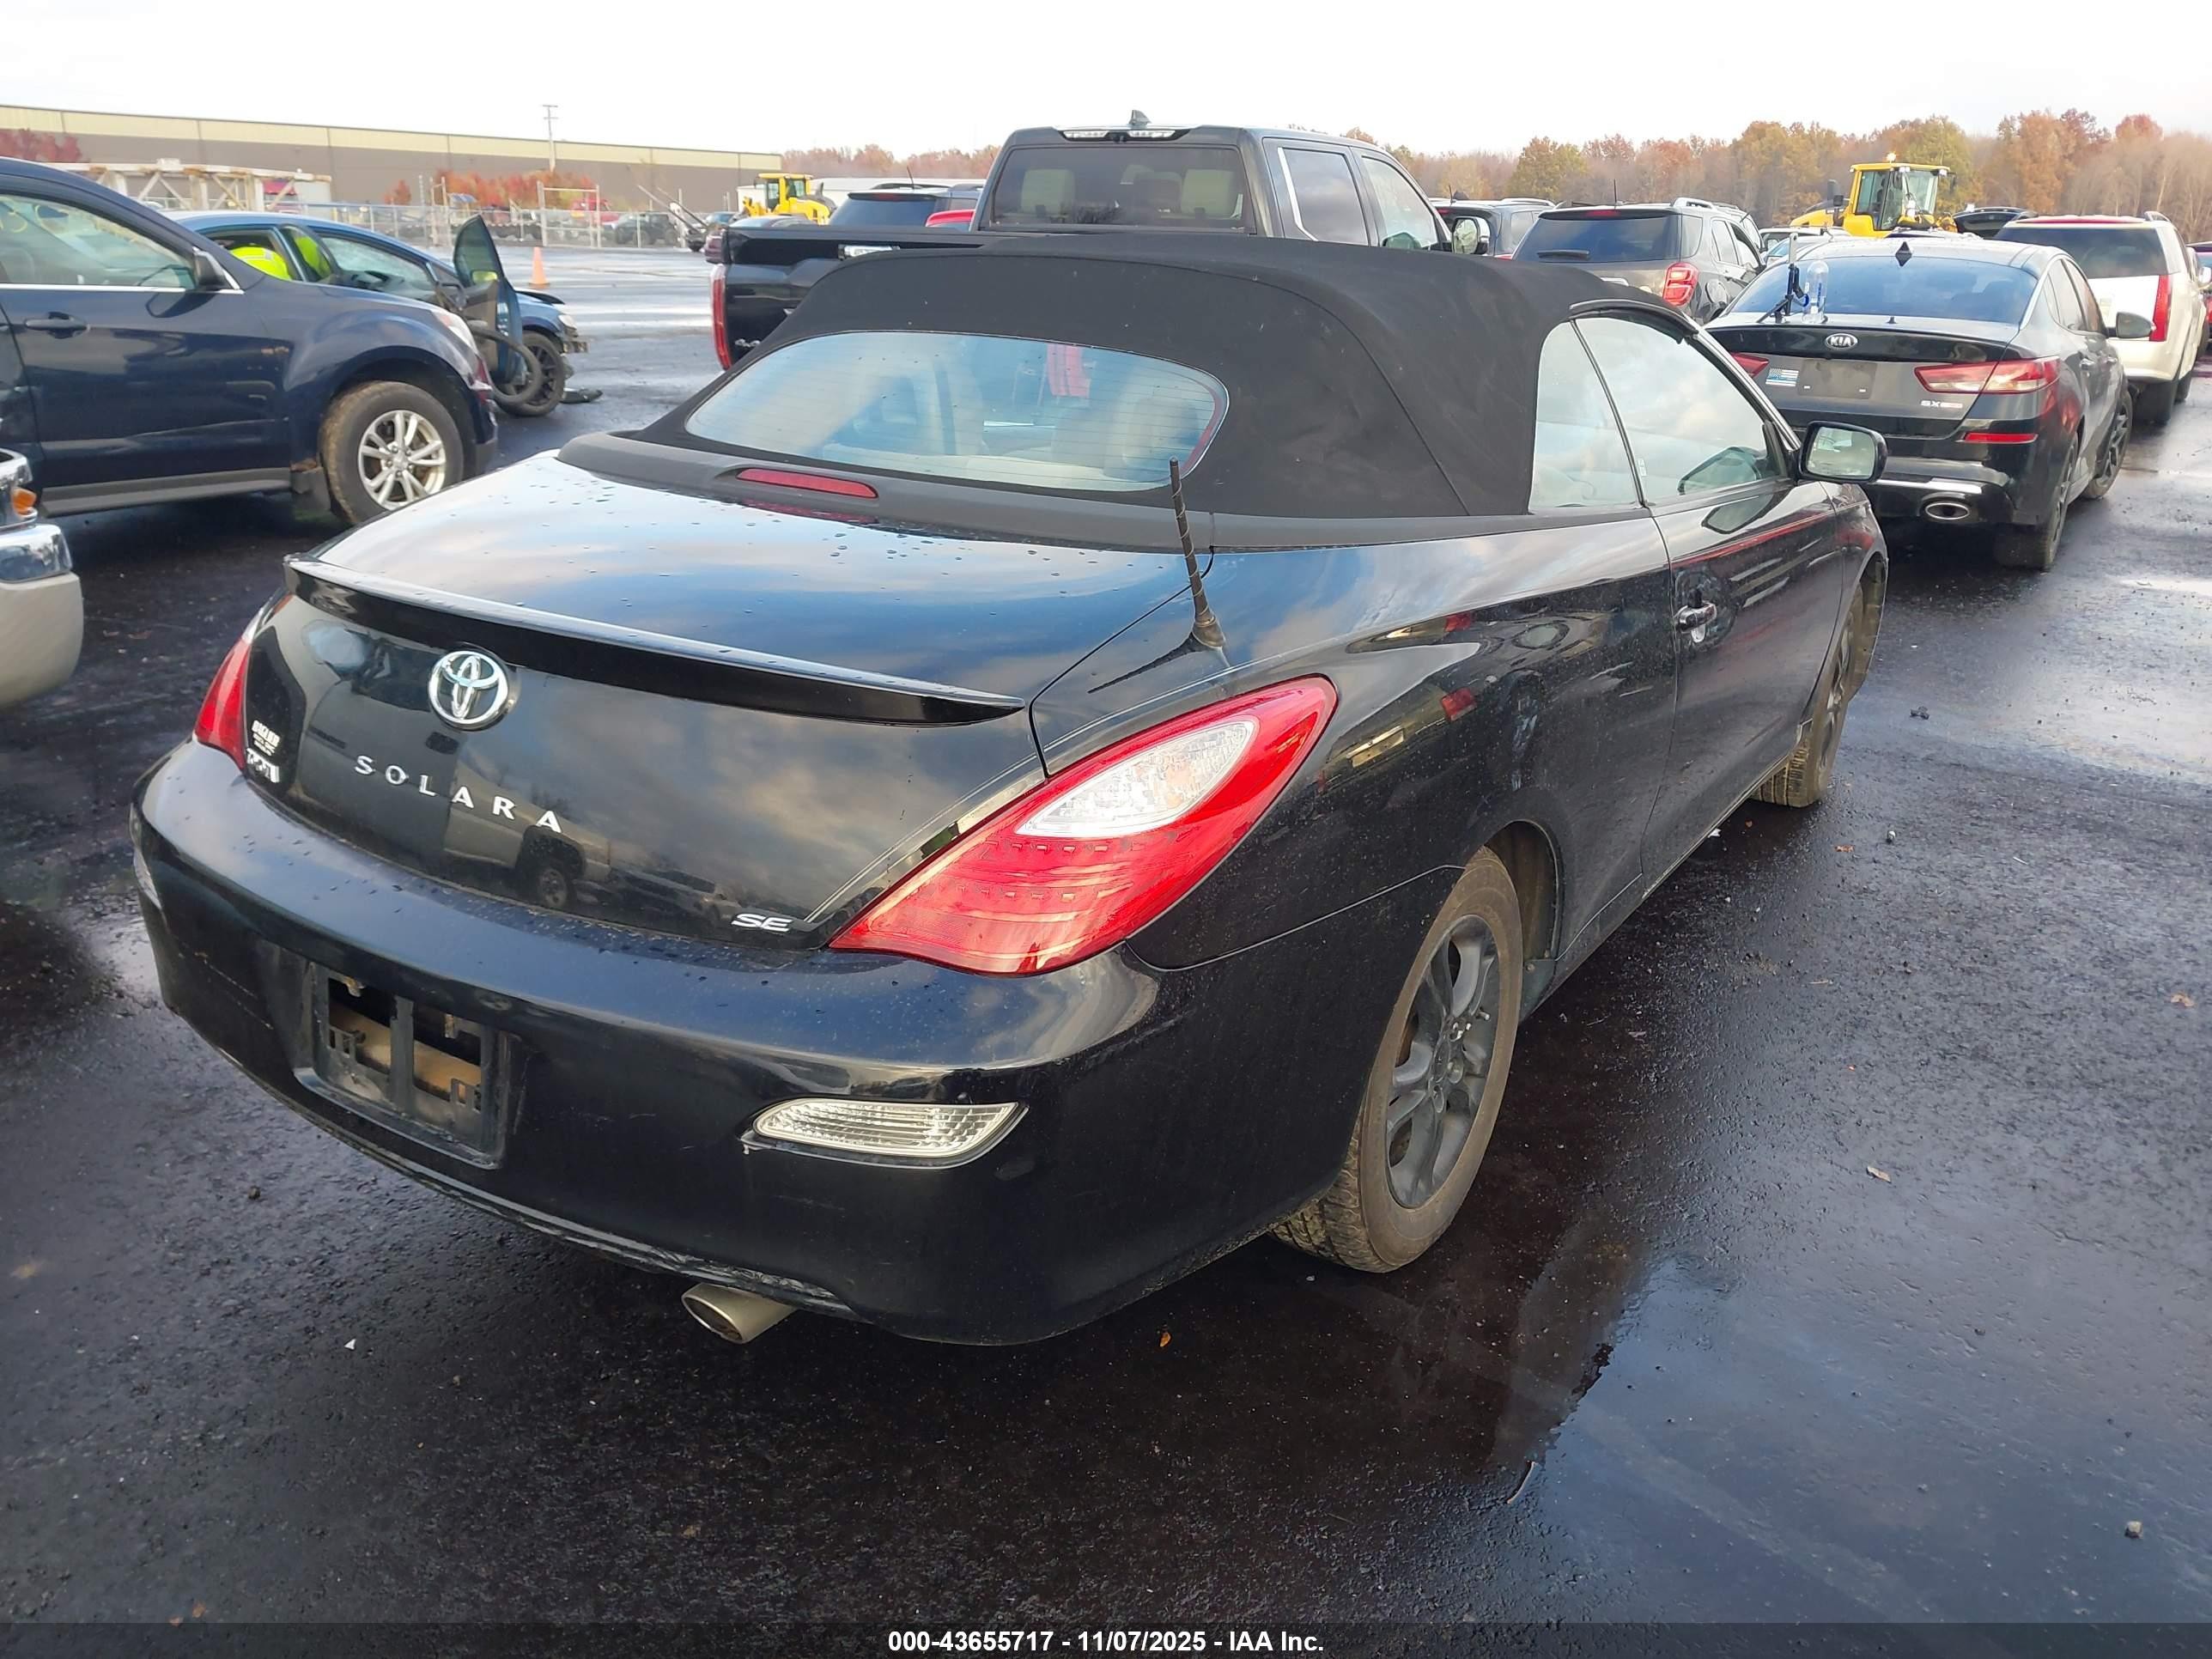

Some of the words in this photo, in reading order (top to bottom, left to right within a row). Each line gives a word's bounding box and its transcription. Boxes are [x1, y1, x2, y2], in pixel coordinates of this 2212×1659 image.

[1830, 336, 1852, 347] KIA
[355, 755, 562, 833] SOLARA
[731, 913, 793, 932] SE
